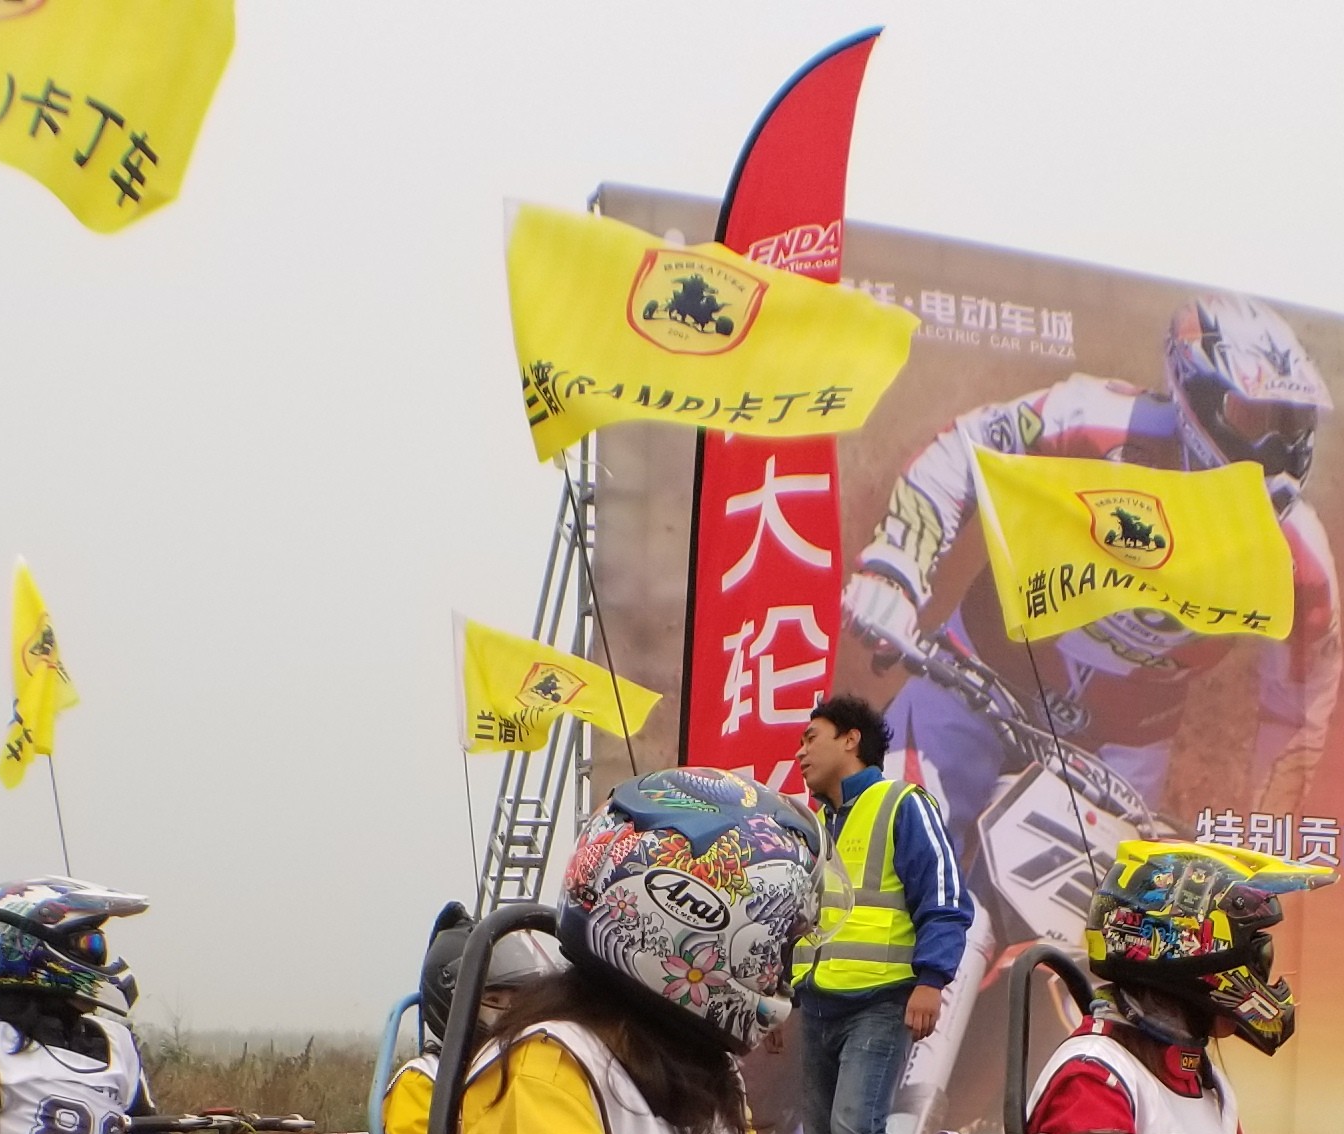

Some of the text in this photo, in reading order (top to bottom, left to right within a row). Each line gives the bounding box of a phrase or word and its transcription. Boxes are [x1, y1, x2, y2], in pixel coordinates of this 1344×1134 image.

[744, 220, 842, 267] ENDA
[913, 324, 1077, 359] LECTRIC CAR PLAZA
[648, 880, 725, 923] Arai
[665, 902, 698, 924] HELMET
